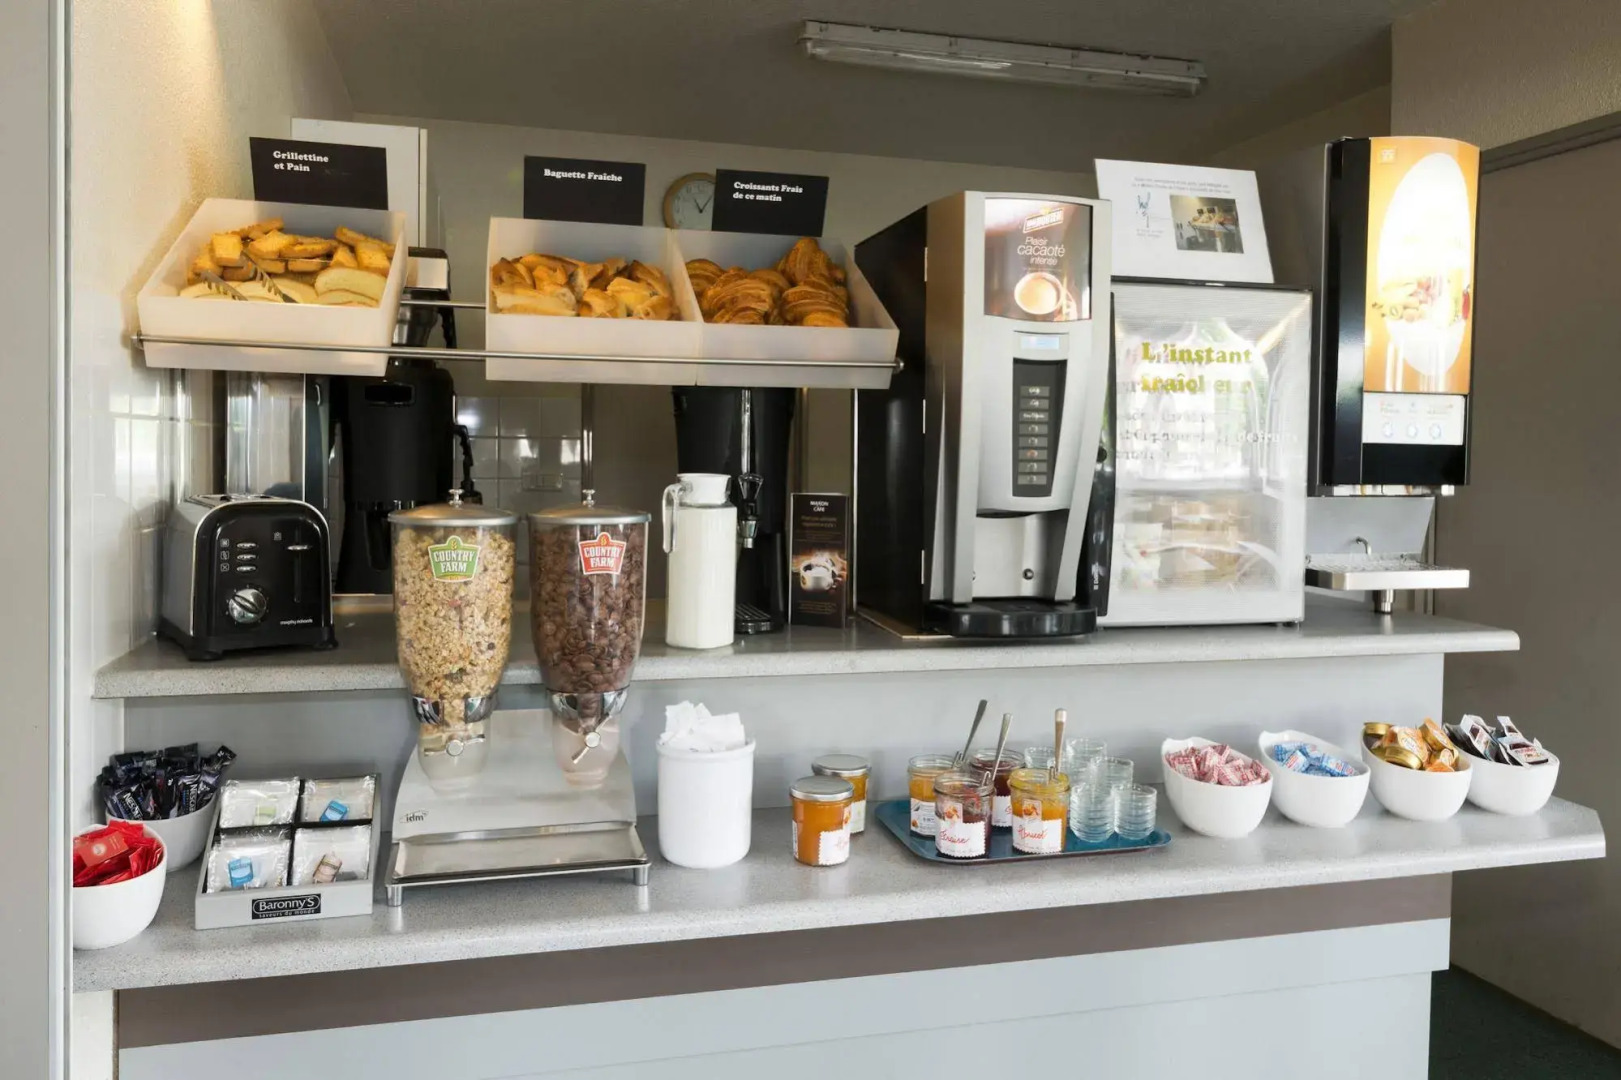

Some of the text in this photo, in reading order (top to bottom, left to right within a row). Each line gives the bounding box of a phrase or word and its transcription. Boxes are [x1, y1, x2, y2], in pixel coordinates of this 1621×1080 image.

[273, 150, 329, 162] Grillettine
[273, 162, 310, 172] et Pain
[543, 168, 586, 179] Baguette
[733, 181, 803, 193] Croissants Frais
[755, 194, 782, 202] matin
[1017, 244, 1066, 257] cacaoté
[1141, 341, 1253, 364] L'instant
[433, 550, 475, 562] COUNTRY
[583, 546, 621, 558] COUNTRY
[440, 561, 467, 573] FARM
[590, 557, 614, 568] FARM
[123, 792, 143, 820] NESCAF
